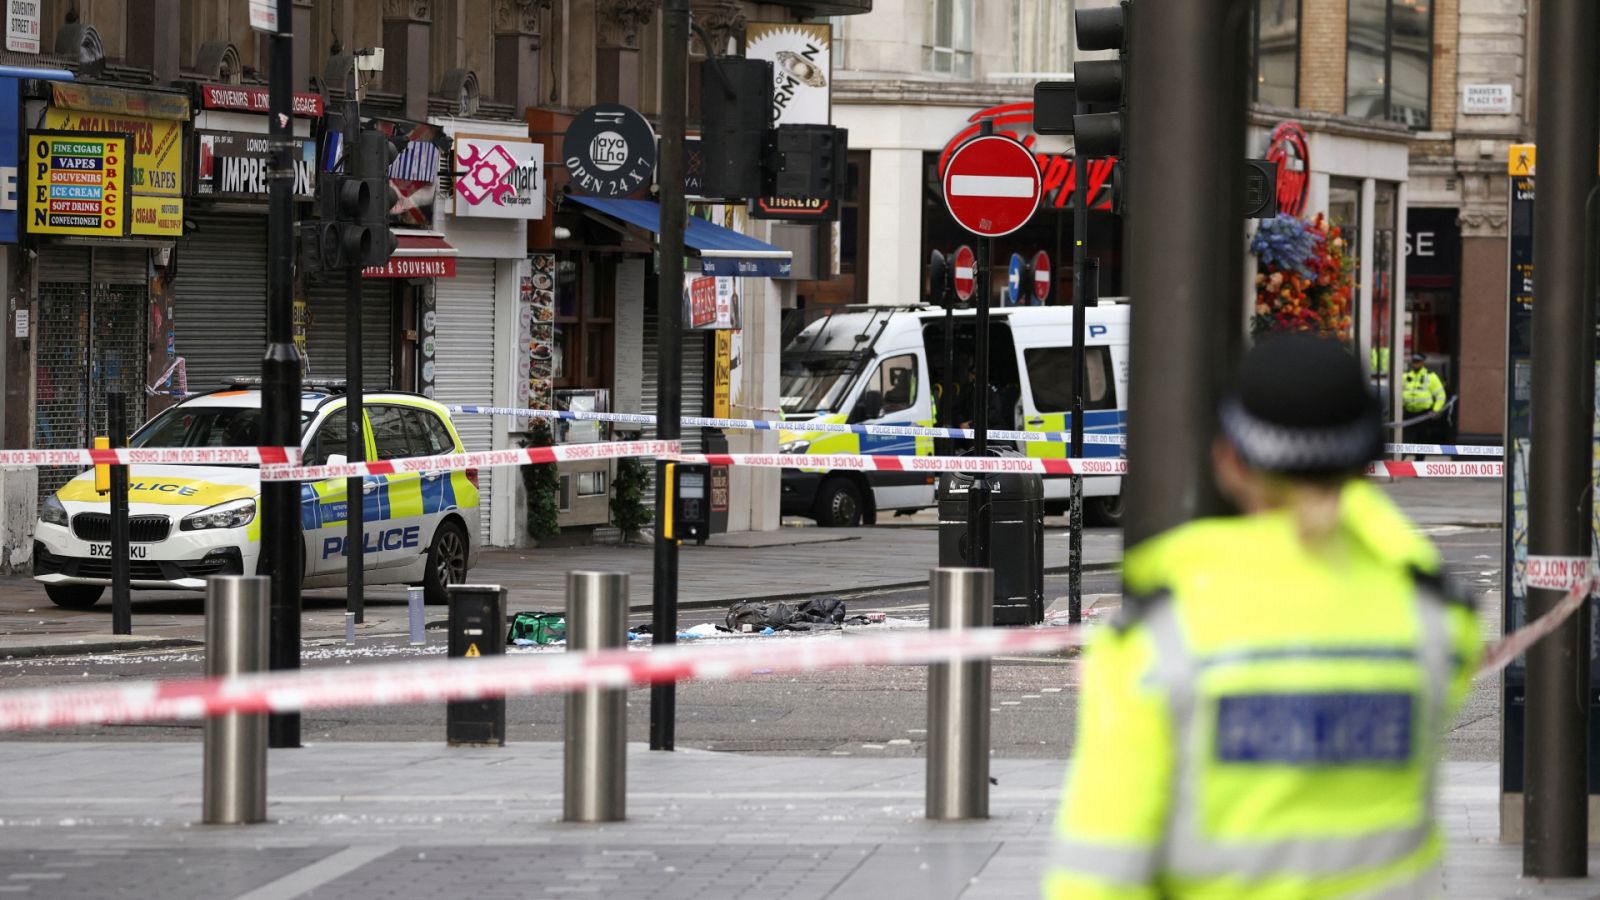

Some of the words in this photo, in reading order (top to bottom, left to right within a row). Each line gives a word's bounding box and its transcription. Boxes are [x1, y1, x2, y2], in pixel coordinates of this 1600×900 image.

[12, 1, 36, 16] COVENTRY
[12, 18, 29, 34] STREET
[211, 89, 248, 106] SOUVENIRS
[293, 96, 317, 113] GGAGE
[1467, 96, 1490, 104] PLACE
[53, 144, 71, 153] FINE
[73, 145, 102, 154] CIGARS
[59, 157, 96, 169] VAPES
[52, 172, 102, 183] SOUVENIRS
[149, 170, 176, 188] VAPES
[222, 156, 310, 194] IMPREON
[566, 156, 604, 193] OPEN
[609, 177, 629, 195] 24
[629, 168, 644, 184] X
[637, 156, 650, 168] 7
[35, 141, 49, 226] OPEN
[103, 143, 118, 229] TOBACCO
[52, 186, 68, 197] ICE
[68, 187, 101, 198] CREAM
[52, 201, 70, 211] SOFT
[71, 202, 99, 212] DRINKS
[51, 216, 100, 226] CONFECTIONERY
[135, 207, 157, 224] CIGARS
[389, 261, 393, 274] &
[398, 261, 446, 275] SOUVENIRS
[503, 408, 514, 416] LINE
[523, 409, 533, 417] NOT
[535, 410, 552, 418] CROSS
[581, 412, 598, 420] POLICE
[600, 413, 611, 421] LINE
[633, 415, 650, 423] CROSS
[681, 416, 697, 425] OLICE
[698, 417, 709, 425] LINE
[730, 419, 747, 427] CROSS
[776, 421, 793, 430] POLICE
[795, 422, 805, 430] LINE
[816, 423, 825, 431] NOT
[827, 424, 844, 432] CROSS
[872, 426, 891, 434] POLICE
[925, 429, 942, 437] CROSS
[989, 431, 1000, 439] LINE
[1011, 432, 1020, 440] NOT
[1022, 432, 1040, 440] CROSS
[565, 446, 594, 458] CROSS
[597, 444, 613, 456] NOT
[616, 443, 628, 454] DO
[630, 442, 650, 454] LINE
[652, 441, 681, 453] POLICE
[1463, 446, 1481, 454] POLICE
[12, 452, 24, 463] DO
[27, 452, 47, 463] LINE
[49, 451, 80, 463] POLICE
[129, 450, 158, 463] CROSS
[162, 450, 179, 462] NOT
[181, 450, 194, 462] DO
[197, 450, 216, 462] LINE
[219, 450, 249, 462] POLICE
[468, 455, 487, 466] LINE
[489, 452, 519, 464] POLICE
[744, 456, 773, 465] CROSS
[777, 456, 793, 465] NOT
[796, 456, 808, 465] DO
[811, 457, 830, 466] LINE
[403, 460, 431, 471] CROSS
[435, 458, 451, 469] NOT
[453, 457, 465, 467] DO
[833, 457, 863, 467] POLICE
[912, 458, 942, 469] CROSS
[945, 459, 961, 470] NOT
[965, 459, 977, 470] DO
[980, 460, 998, 470] LINE
[1003, 460, 1032, 471] POLICE
[1082, 461, 1112, 472] CROSS
[1115, 461, 1127, 472] OT
[273, 470, 289, 479] NOT
[292, 469, 304, 478] DO
[307, 467, 325, 477] LINE
[327, 465, 357, 476] POLICE
[1426, 464, 1457, 475] CROSS
[1461, 464, 1478, 475] NOT
[1481, 464, 1493, 475] DO
[130, 482, 199, 497] LICE
[90, 544, 112, 557] BX2
[130, 546, 146, 558] KU
[1545, 559, 1568, 577] NOT
[1571, 560, 1586, 578] DO
[1222, 704, 1406, 760] POLICE
